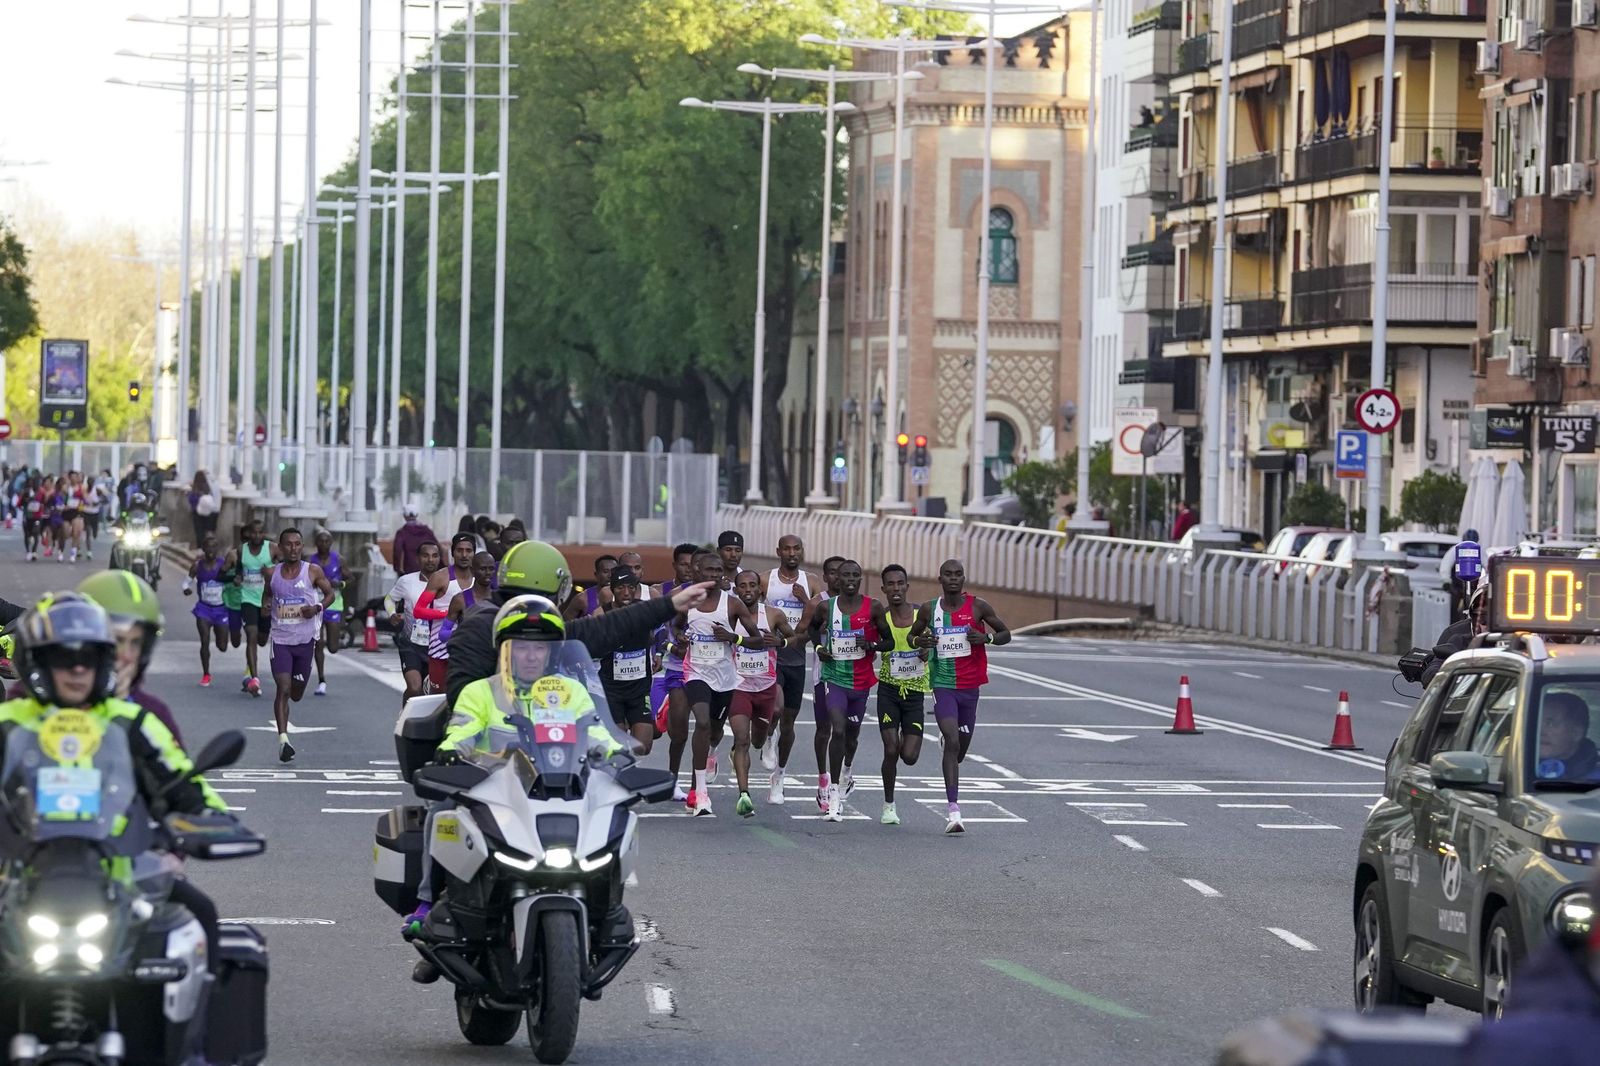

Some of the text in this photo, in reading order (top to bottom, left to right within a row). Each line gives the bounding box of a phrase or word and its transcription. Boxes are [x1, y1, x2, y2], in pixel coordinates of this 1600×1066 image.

[1542, 418, 1592, 430] TINTE
[1554, 431, 1586, 452] 5€
[1340, 435, 1360, 460] P
[837, 646, 859, 654] PACER
[741, 661, 764, 669] DEGEFA
[898, 665, 917, 673] ADISU
[620, 666, 641, 674] KITATA
